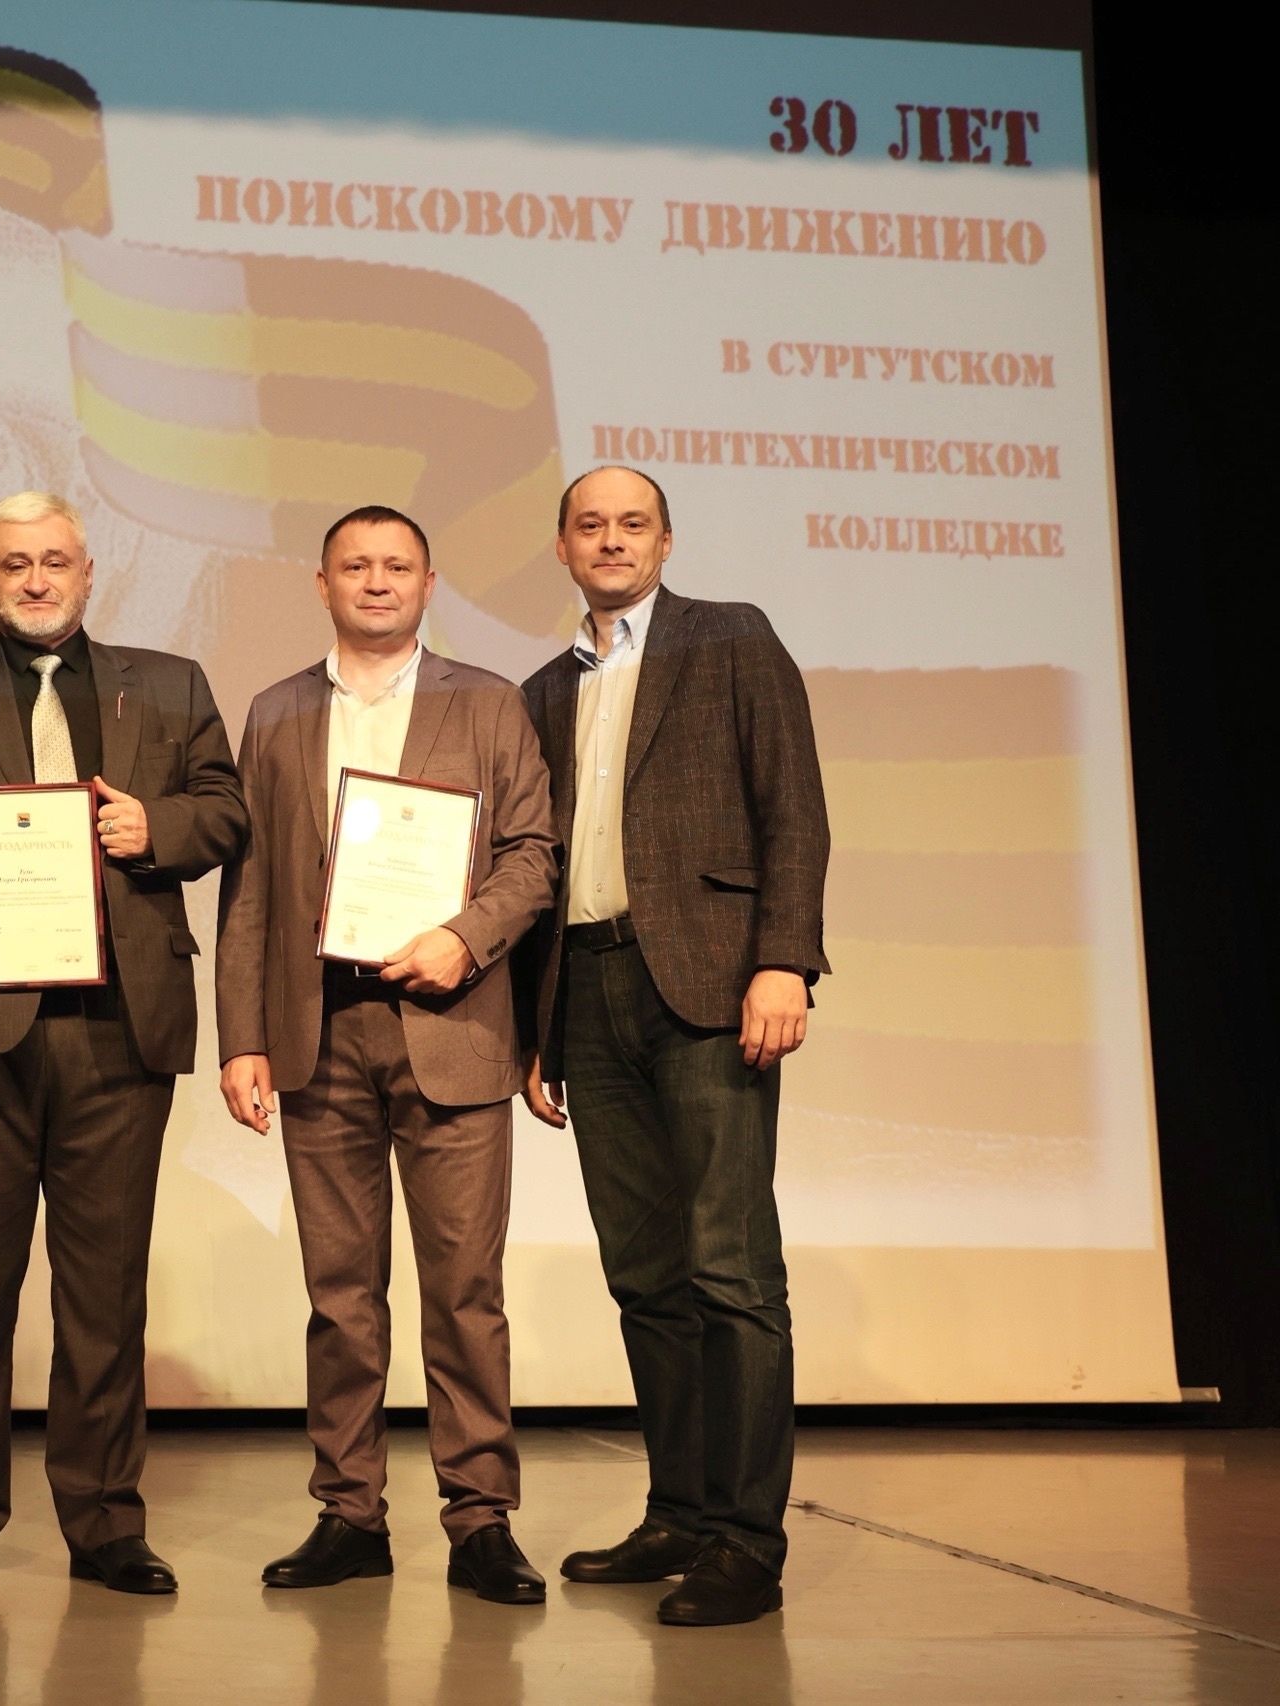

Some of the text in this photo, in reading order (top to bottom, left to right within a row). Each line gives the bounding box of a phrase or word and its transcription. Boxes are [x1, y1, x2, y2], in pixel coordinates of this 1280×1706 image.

[770, 97, 1039, 167] 30 ЛЕТ
[195, 175, 1047, 266] ПОИСКОВОМУ ДВИЖЕНИЮ
[721, 339, 1056, 389] В СУРГУТСКОМ
[592, 424, 1061, 479] ПОЛИТЕХНИЧЕСКОМ
[805, 514, 1065, 560] КОЛЛЕДЖЕ
